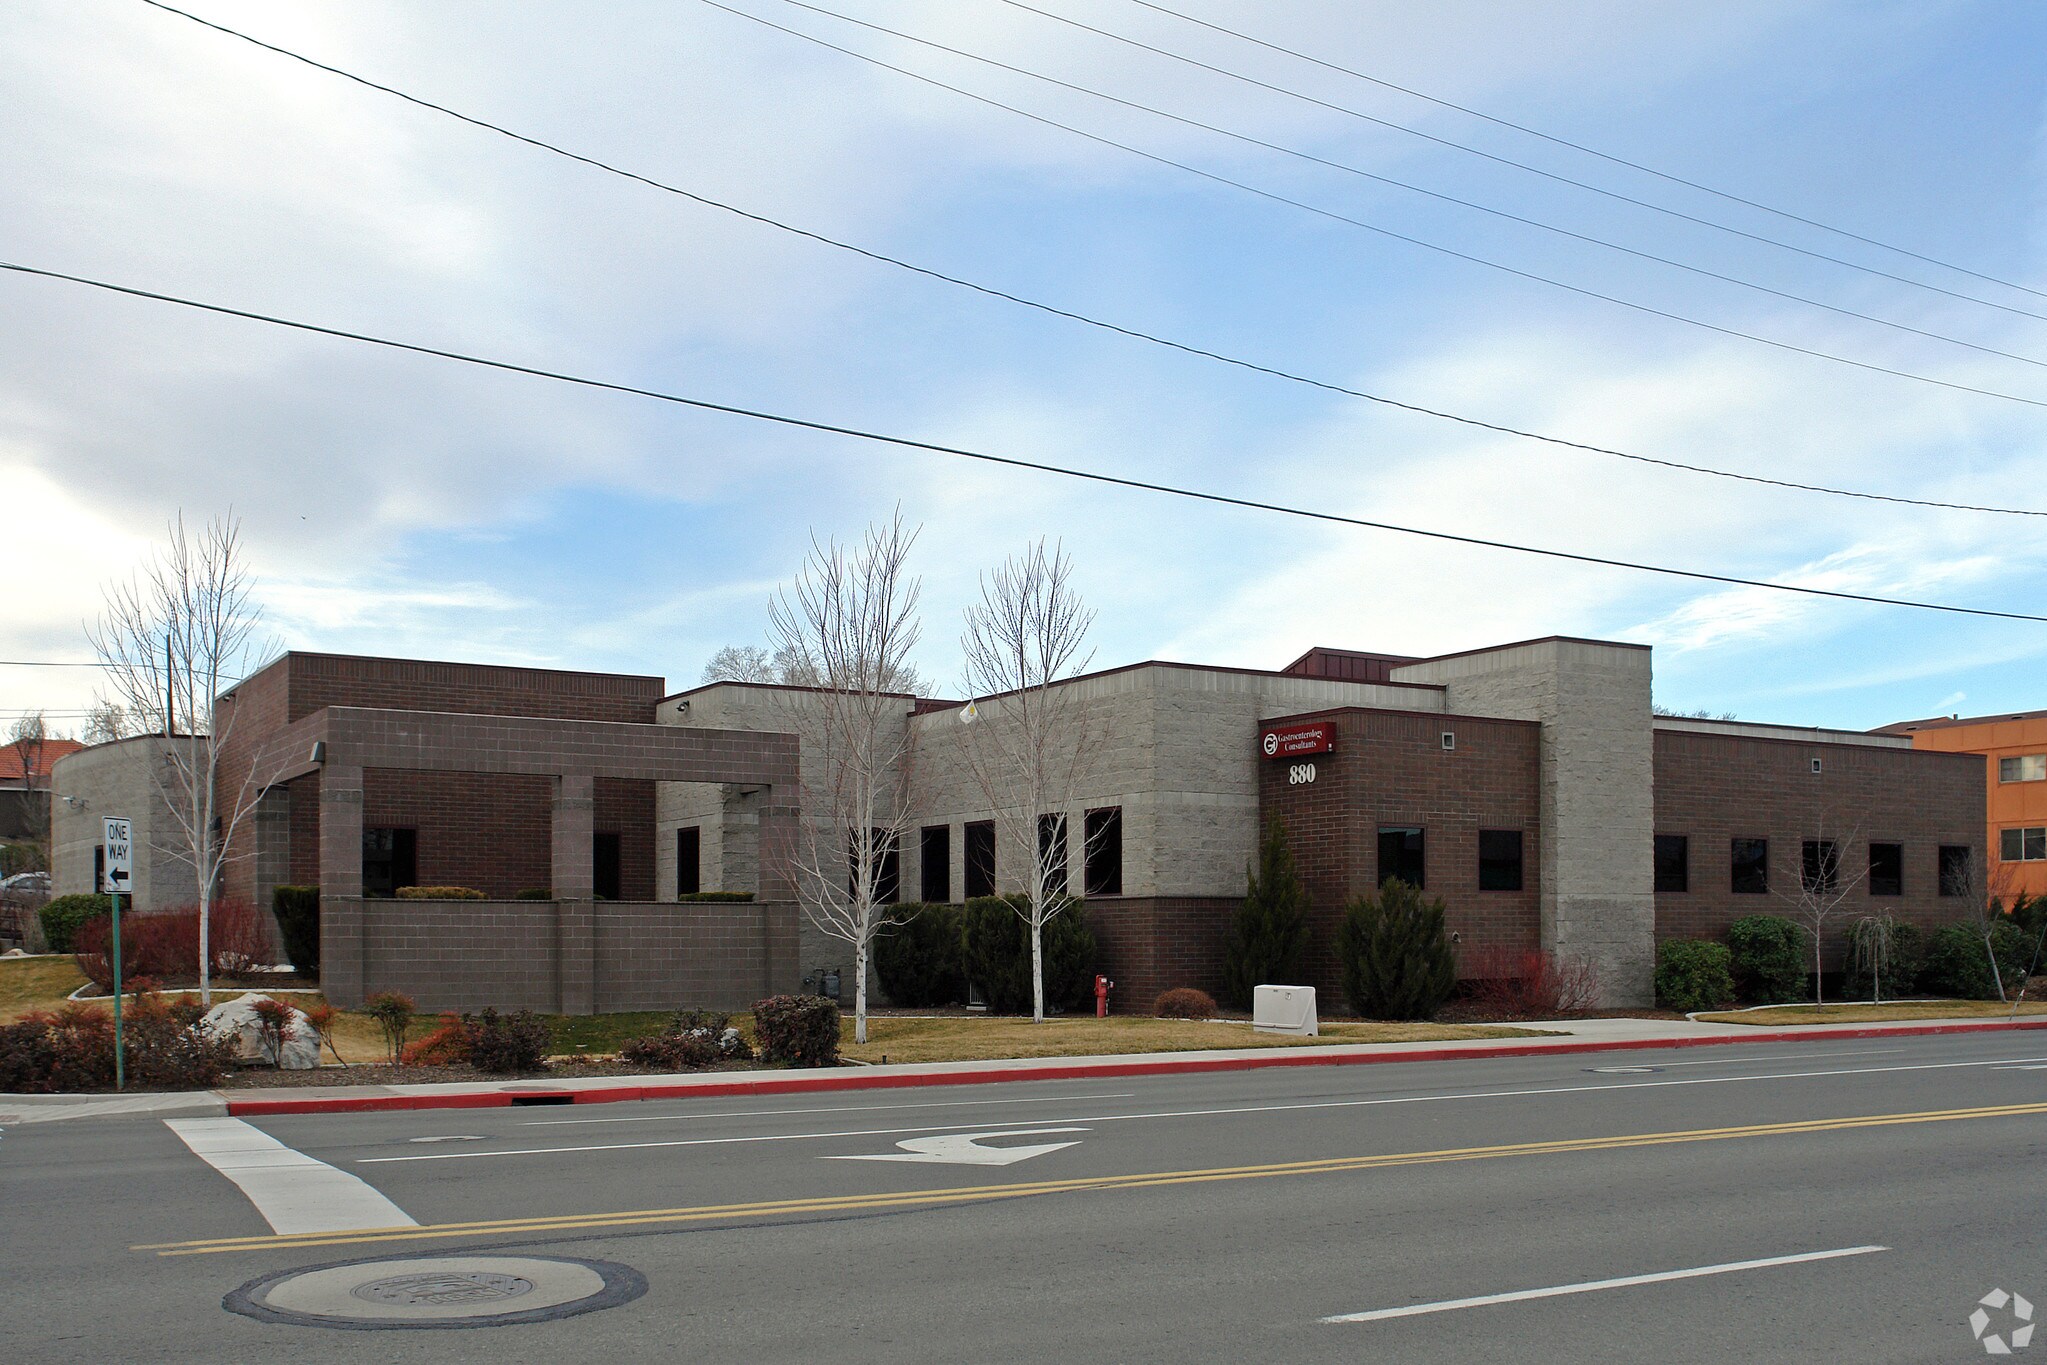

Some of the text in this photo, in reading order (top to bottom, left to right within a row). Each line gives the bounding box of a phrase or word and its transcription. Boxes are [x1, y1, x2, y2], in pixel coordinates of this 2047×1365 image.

[1278, 729, 1322, 742] Gastroenterology
[1284, 740, 1317, 752] Consultants
[1289, 763, 1316, 785] 880
[108, 824, 127, 840] ONE
[108, 843, 128, 860] WAY
